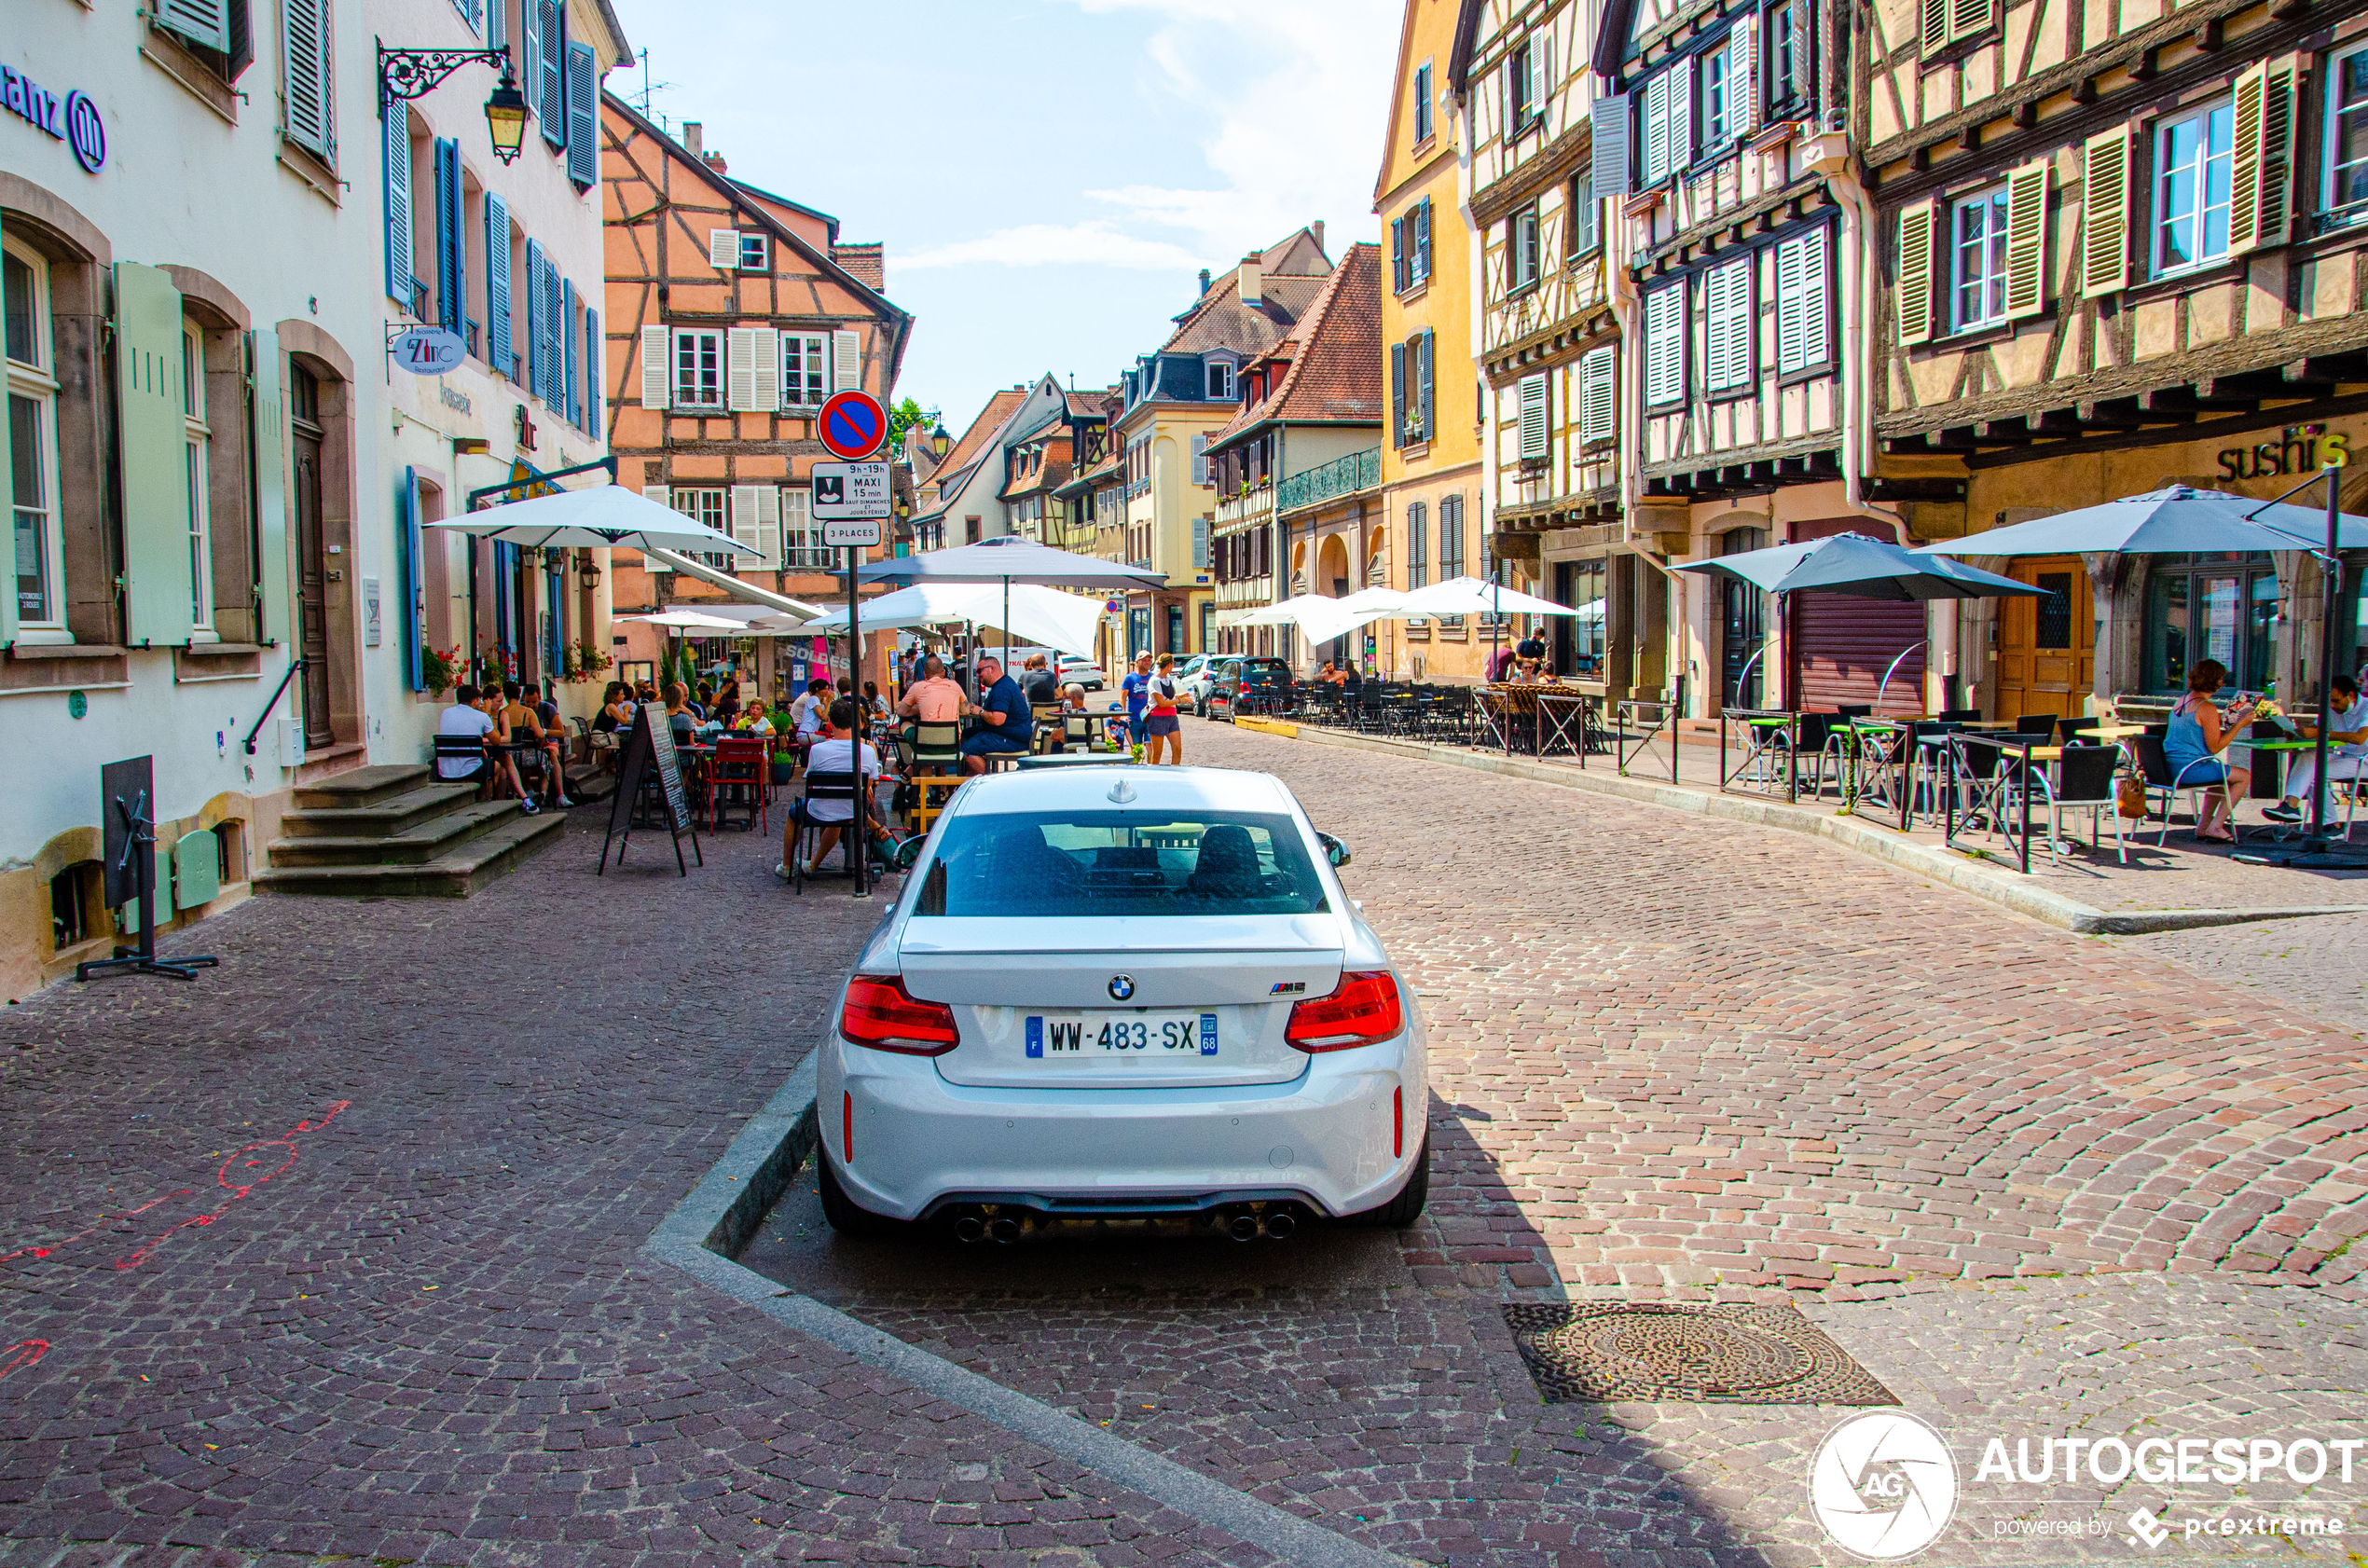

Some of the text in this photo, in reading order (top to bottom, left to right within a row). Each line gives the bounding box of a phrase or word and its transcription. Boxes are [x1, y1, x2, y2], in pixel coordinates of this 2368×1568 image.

[415, 365, 446, 374] Restaurant
[854, 478, 881, 487] MAXI
[854, 488, 866, 497] 15
[839, 529, 874, 537] PLACES
[786, 644, 851, 670] SOLDES
[1050, 1022, 1194, 1051] WW-483-SX
[1031, 1041, 1037, 1050] F
[1203, 1037, 1216, 1050] 68
